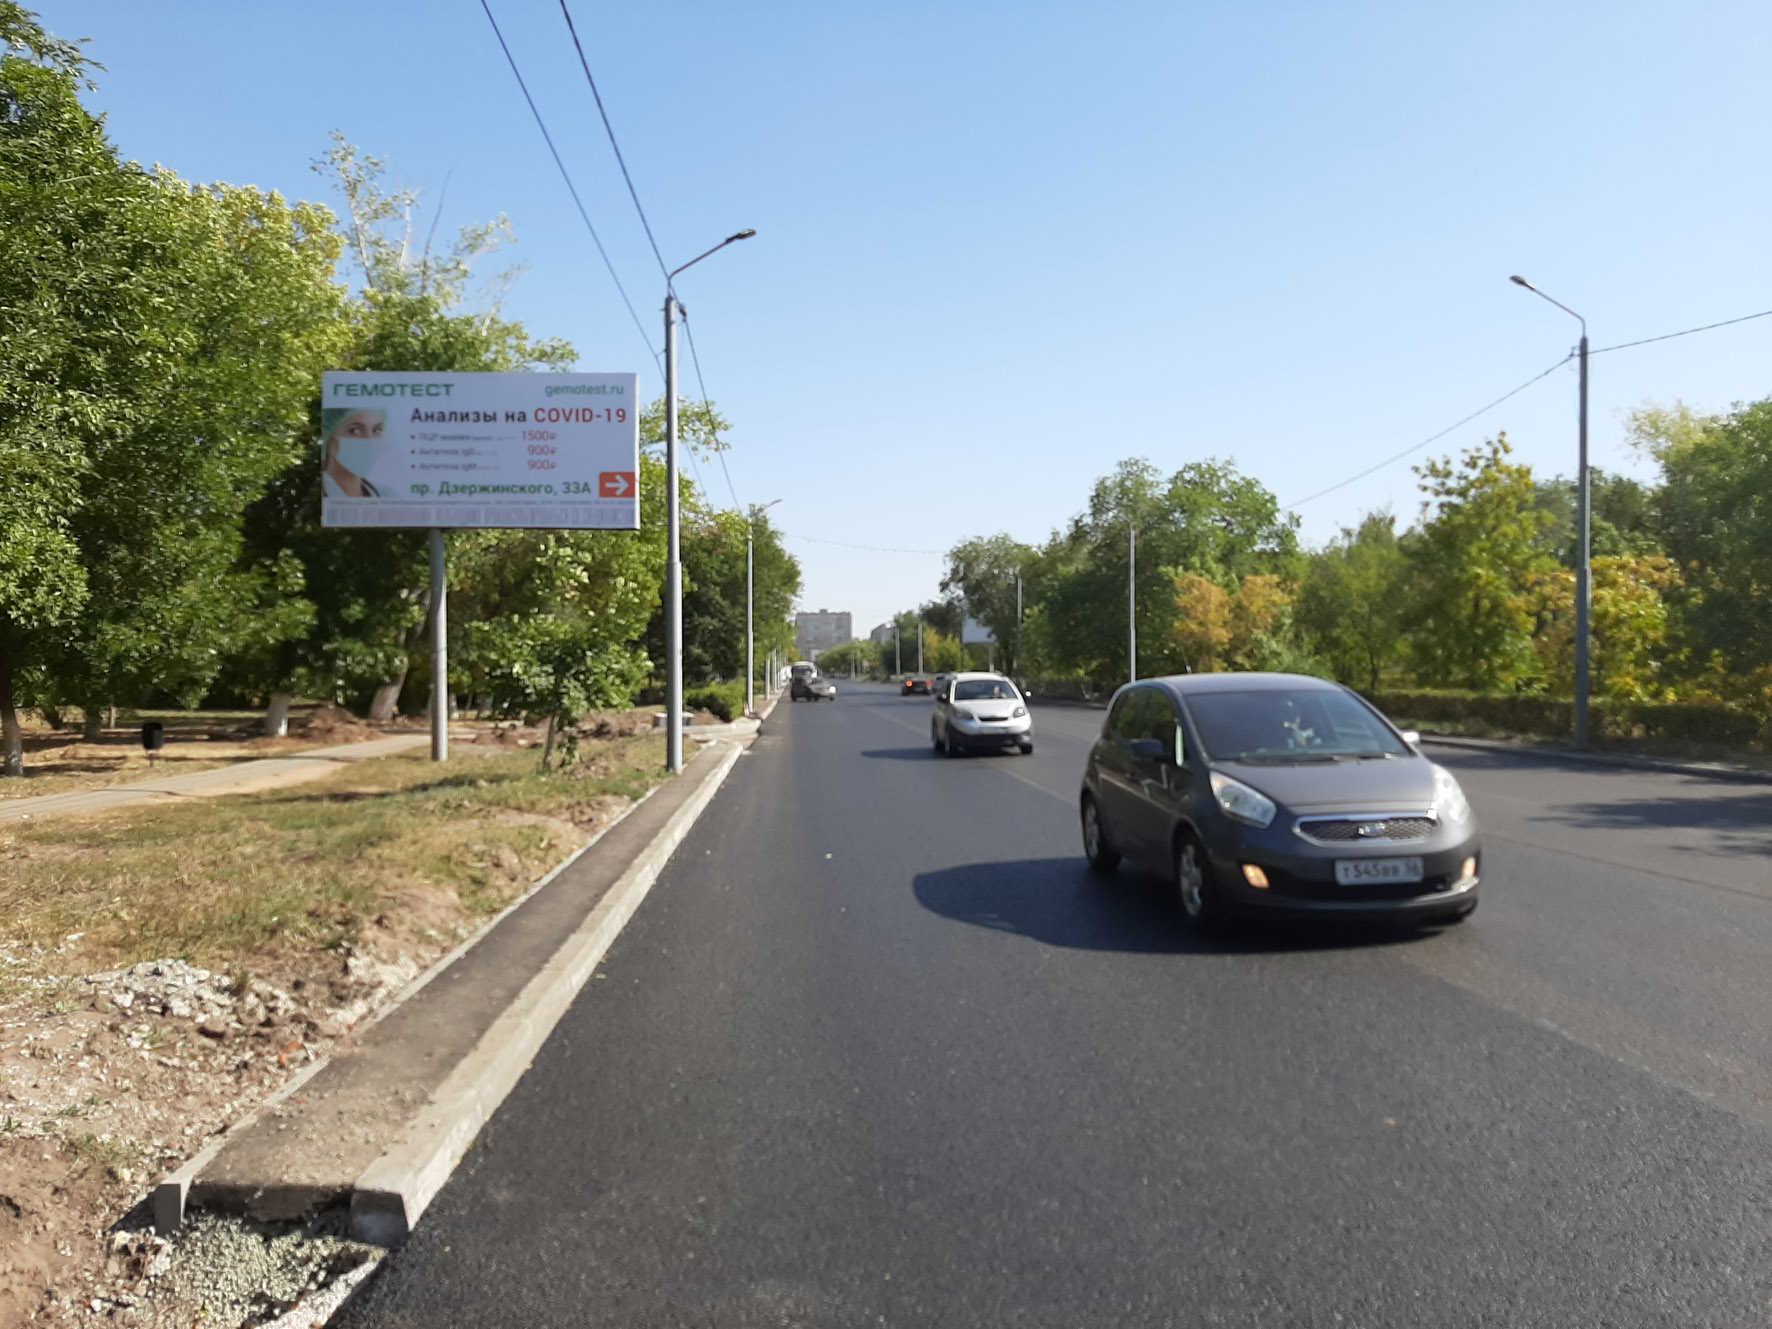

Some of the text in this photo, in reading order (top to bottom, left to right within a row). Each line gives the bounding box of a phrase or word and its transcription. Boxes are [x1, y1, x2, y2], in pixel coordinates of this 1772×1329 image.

[333, 383, 455, 397] ГЕМОТЕСТ
[545, 384, 624, 397] gemotest.ru
[411, 407, 627, 423] Анализы на COVID-19
[411, 481, 592, 497] пр. Дзержинского, 33А
